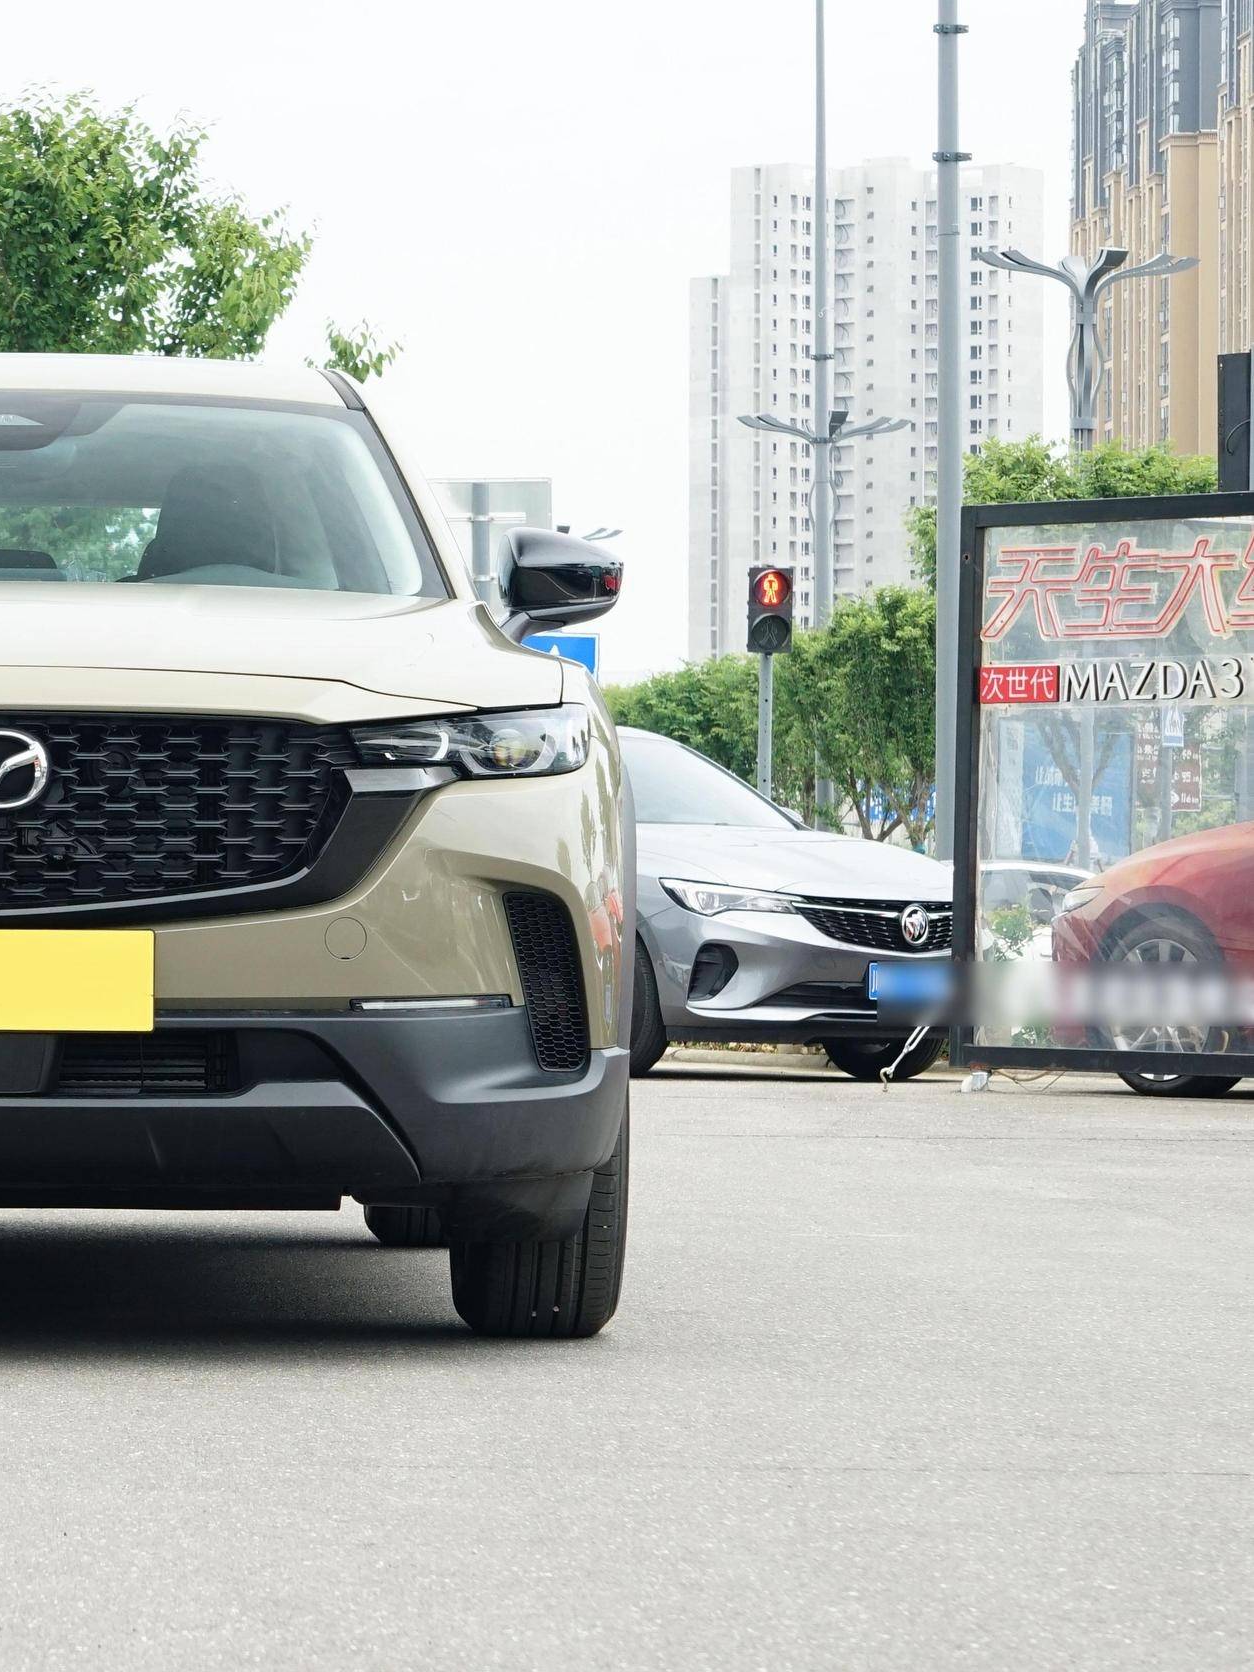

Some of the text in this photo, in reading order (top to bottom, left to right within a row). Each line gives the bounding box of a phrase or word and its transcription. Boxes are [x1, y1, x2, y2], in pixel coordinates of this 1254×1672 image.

[981, 656, 1244, 701] 次世代 MAZDA3
